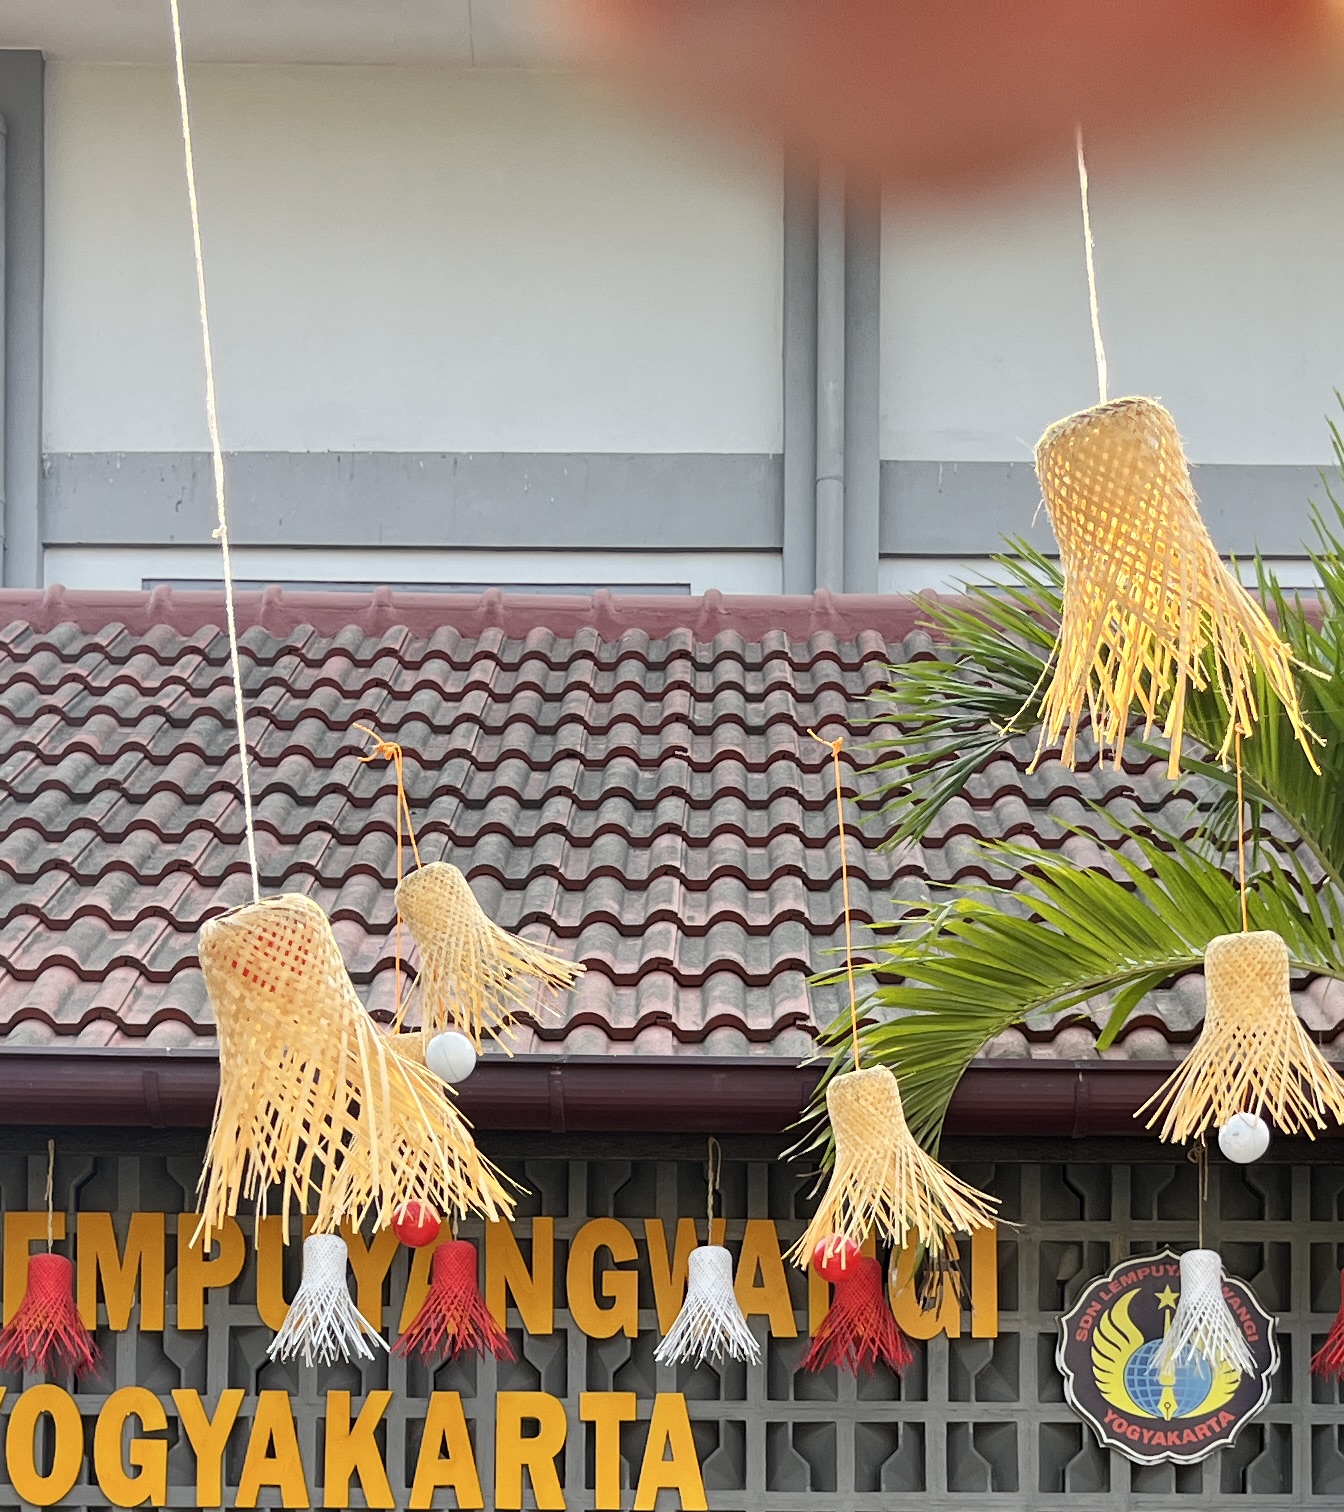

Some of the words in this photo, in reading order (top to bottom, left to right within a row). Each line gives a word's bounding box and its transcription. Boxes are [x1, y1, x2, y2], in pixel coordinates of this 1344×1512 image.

[1075, 1301, 1102, 1342] SDN
[1099, 1264, 1259, 1342] LEMPUYANGI
[1103, 1409, 1236, 1446] YOGYAKARTA
